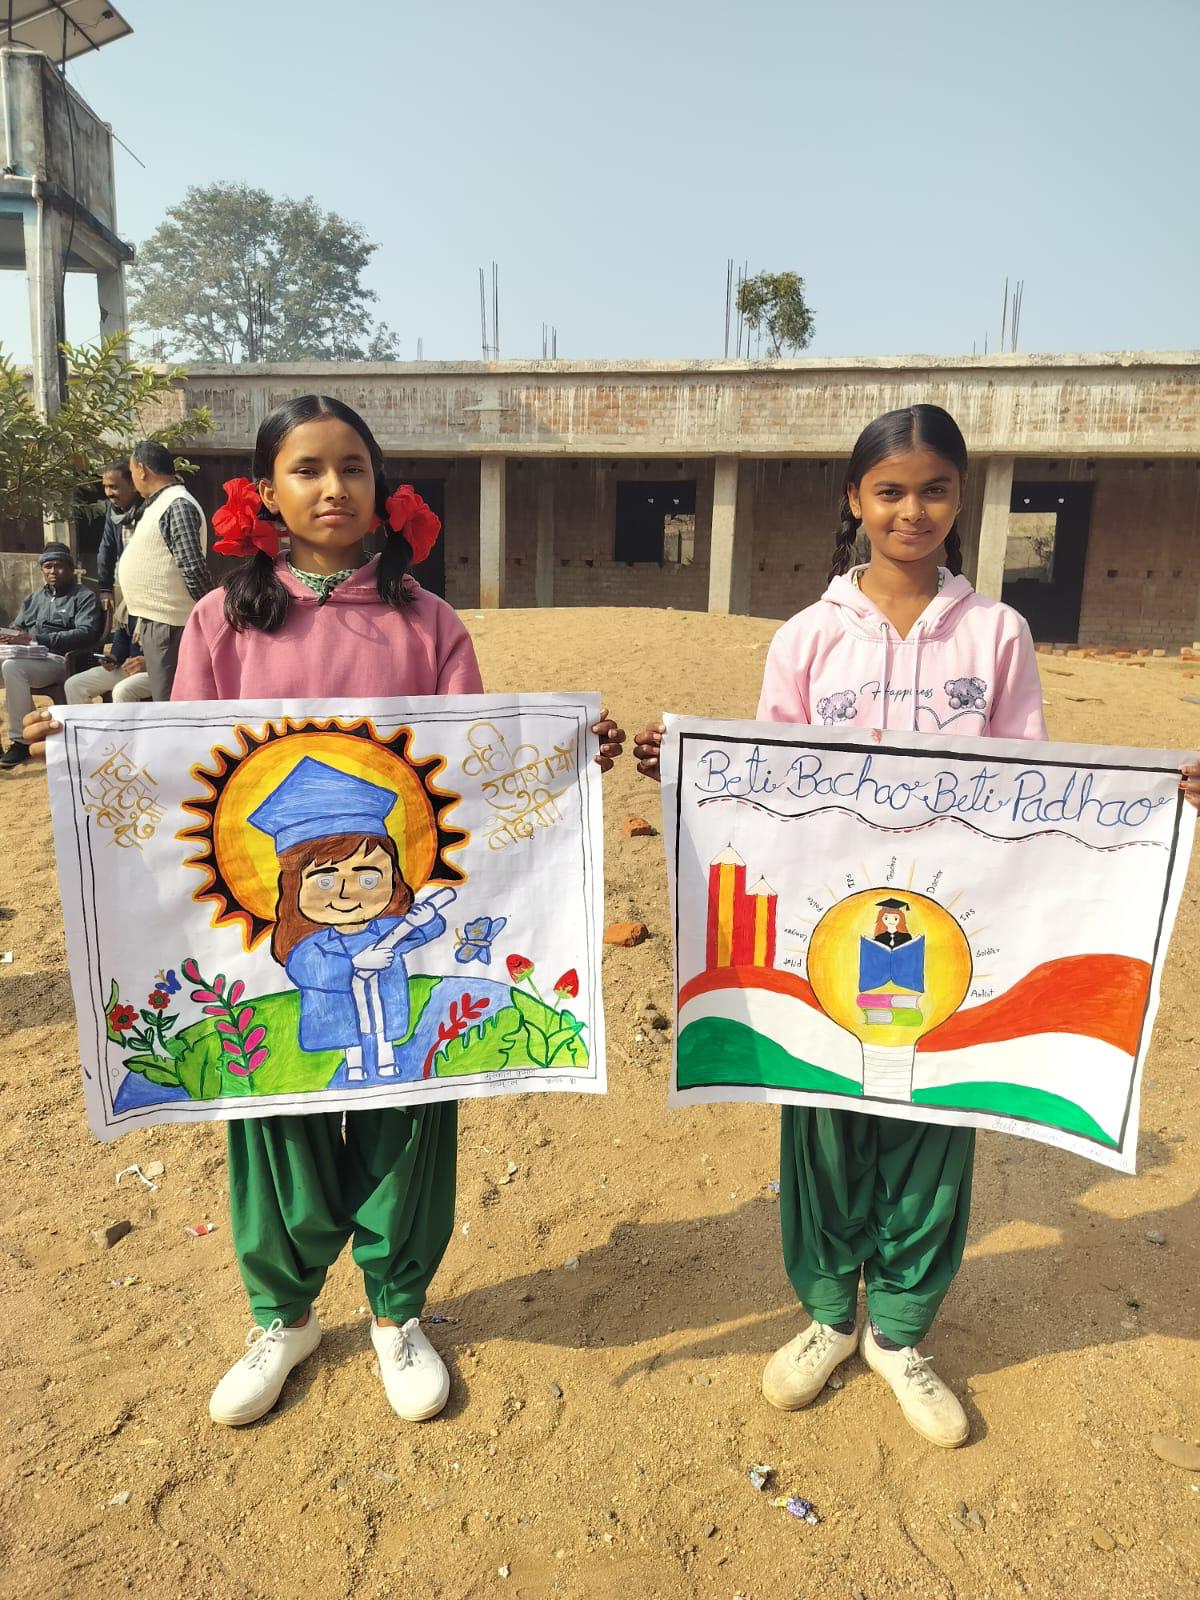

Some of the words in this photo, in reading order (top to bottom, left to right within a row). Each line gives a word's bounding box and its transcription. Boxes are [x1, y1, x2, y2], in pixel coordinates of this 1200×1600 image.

[695, 746, 783, 796] Beti
[786, 754, 923, 811] Bachao
[921, 767, 1006, 813] Beti
[1004, 769, 1173, 827] Padhao
[959, 908, 976, 922] IAS
